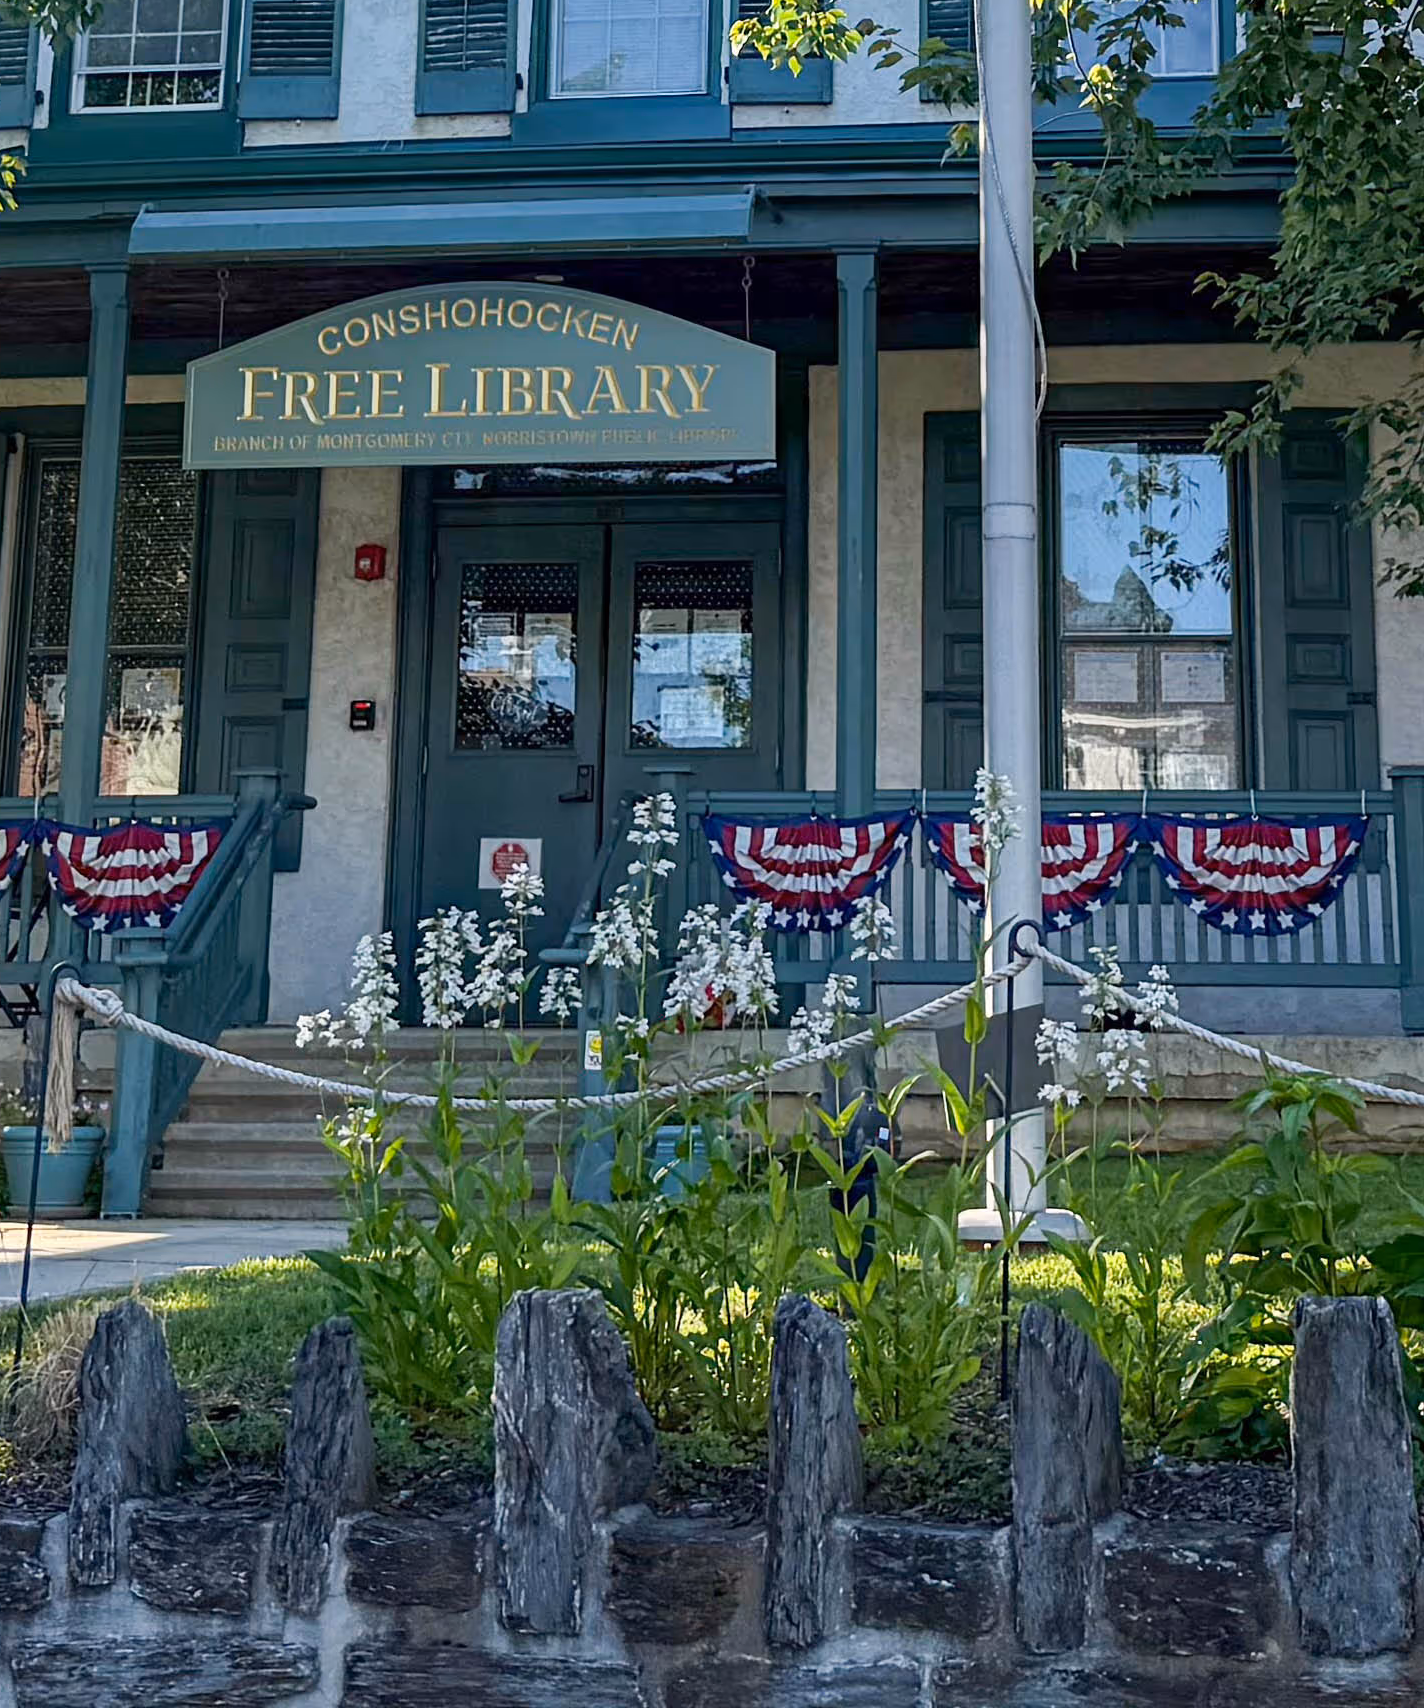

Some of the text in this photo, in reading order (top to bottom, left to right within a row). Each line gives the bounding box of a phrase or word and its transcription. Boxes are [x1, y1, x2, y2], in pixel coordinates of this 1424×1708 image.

[317, 298, 639, 355] CONSHOHOCKEN
[236, 363, 721, 426] FREE LIBRARY
[214, 435, 284, 452] BRANCH
[289, 434, 308, 451] OF
[317, 432, 435, 450] MONTGOMERY
[482, 429, 597, 445] NORRISTOWN
